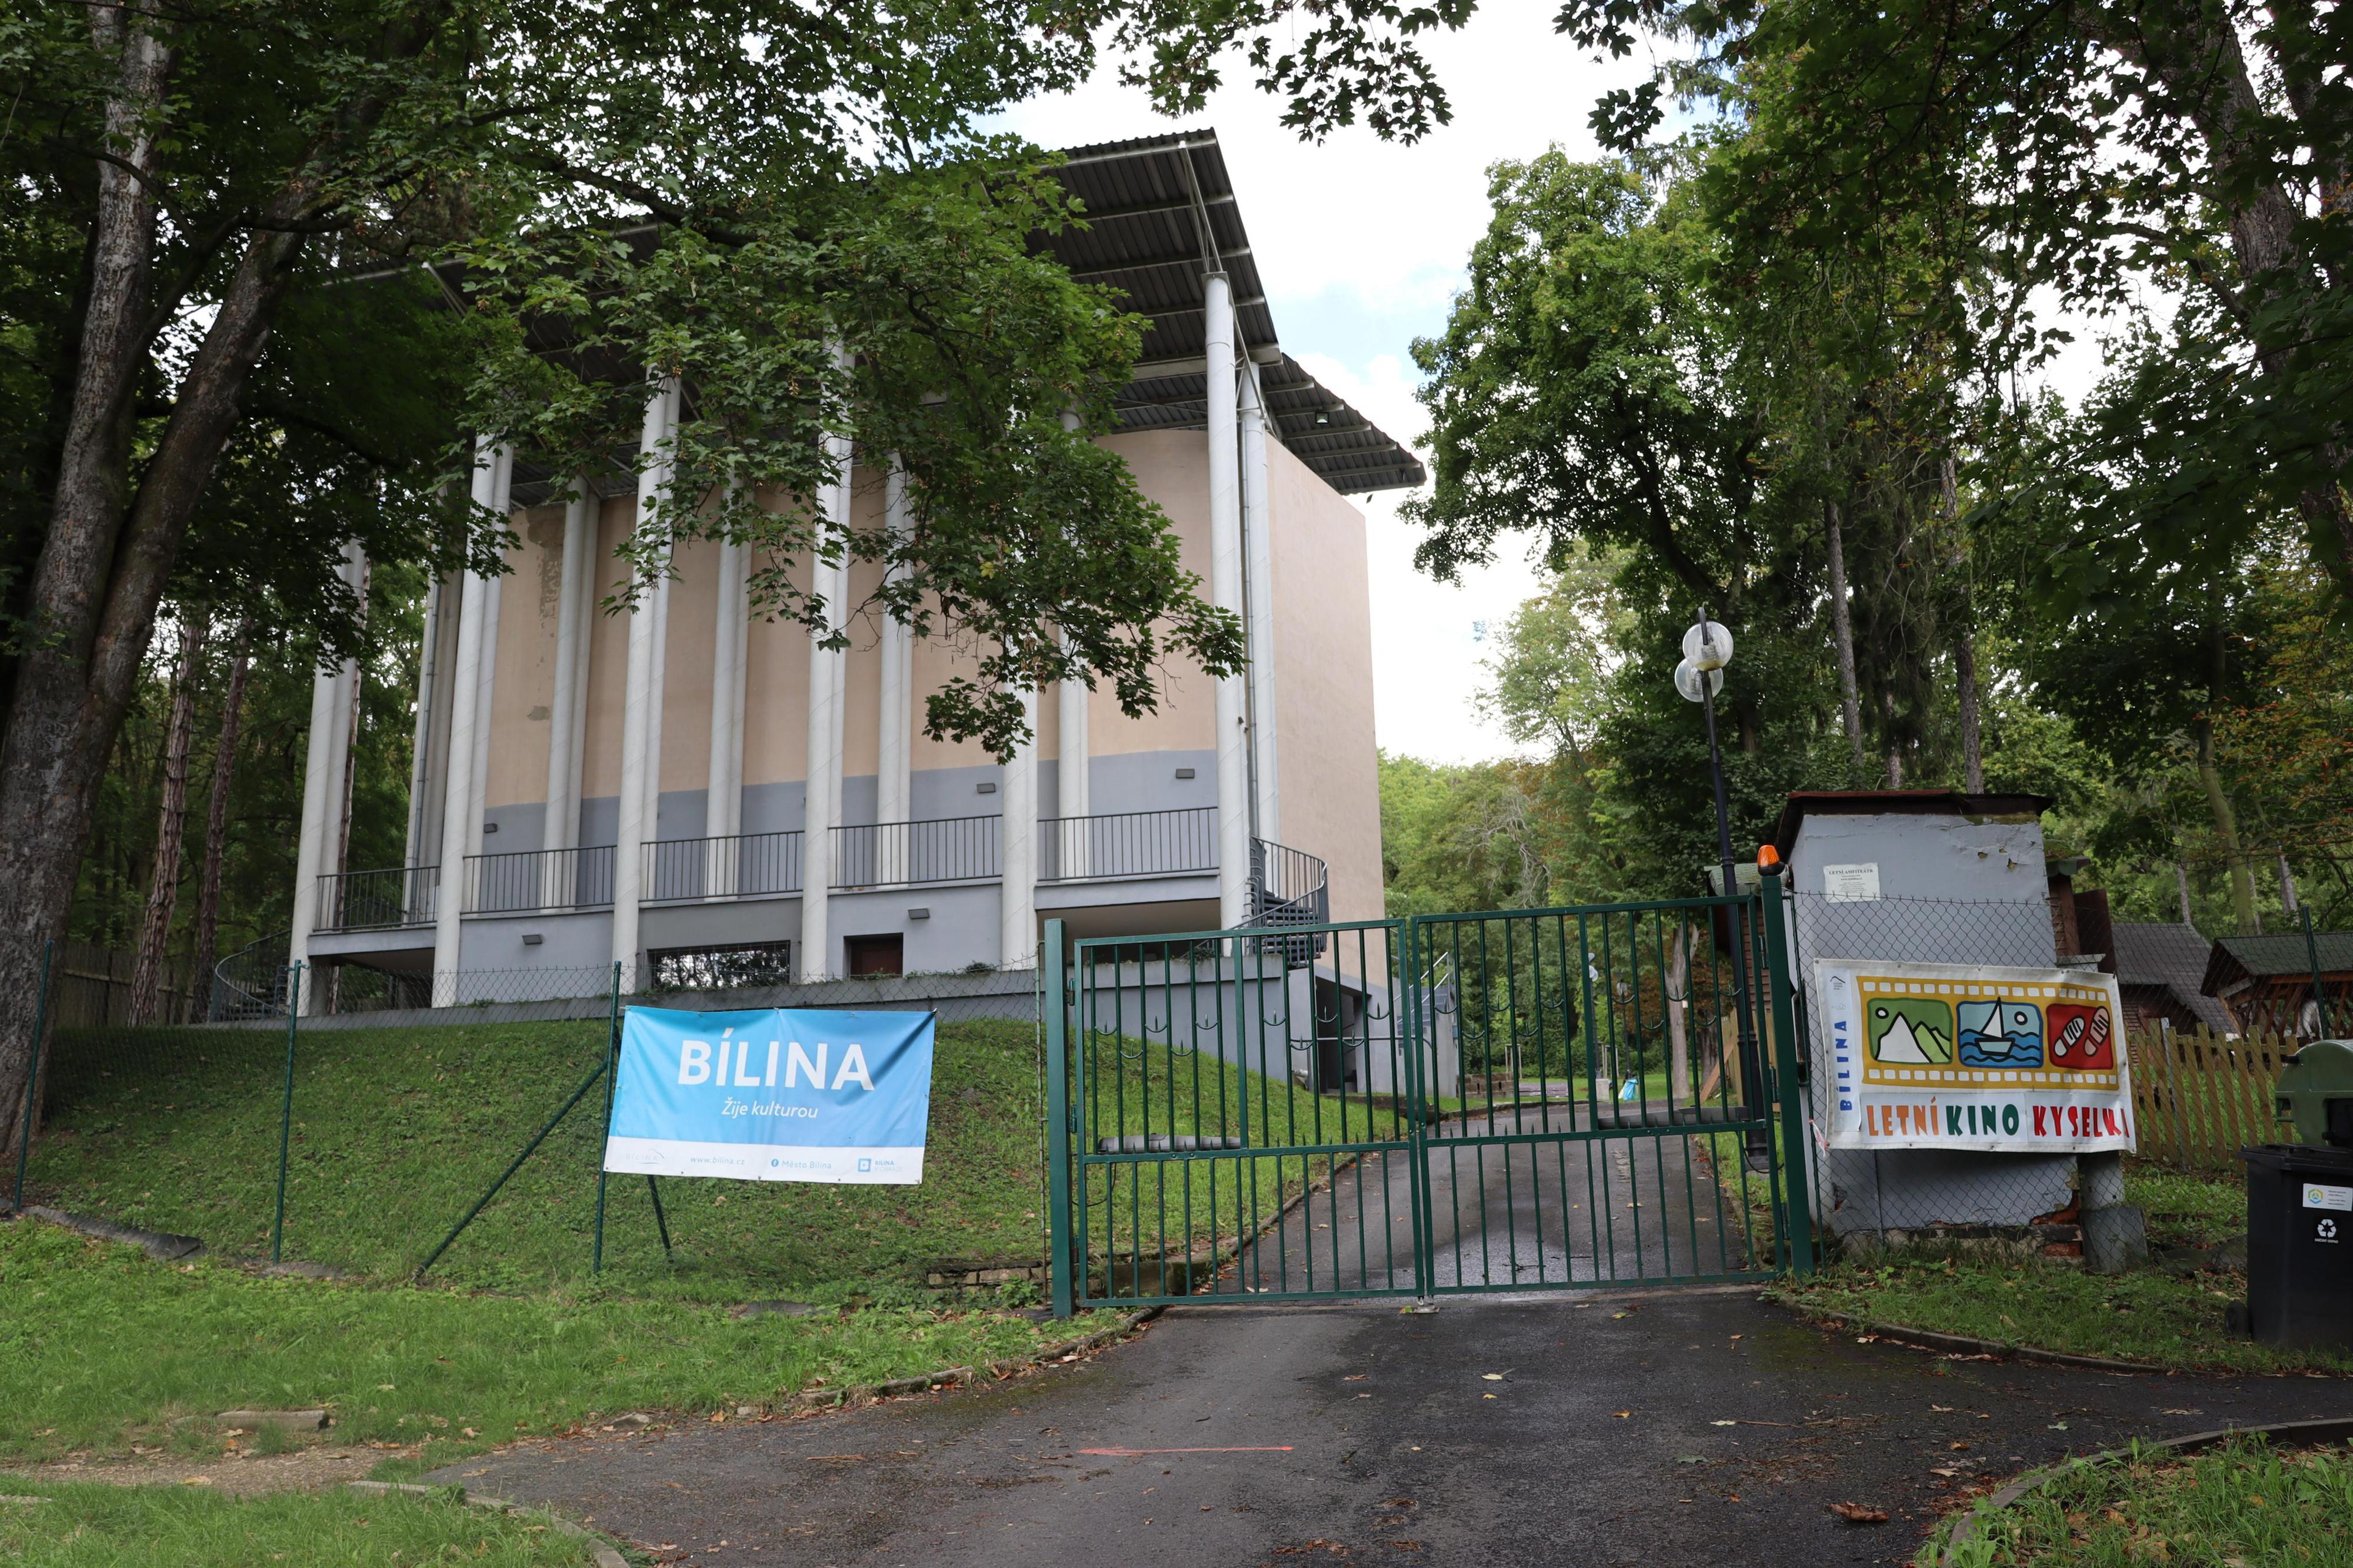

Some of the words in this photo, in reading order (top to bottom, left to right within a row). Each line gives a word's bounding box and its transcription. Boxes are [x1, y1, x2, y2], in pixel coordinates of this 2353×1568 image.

[678, 1027, 875, 1091] BÍLINA
[1834, 1020, 1852, 1111] BÍLINA
[721, 1096, 748, 1119] Žije
[752, 1100, 818, 1118] kulturou
[1866, 1095, 1939, 1137] LETNÍ
[1945, 1103, 2019, 1137] KINO
[782, 1160, 807, 1169] Město
